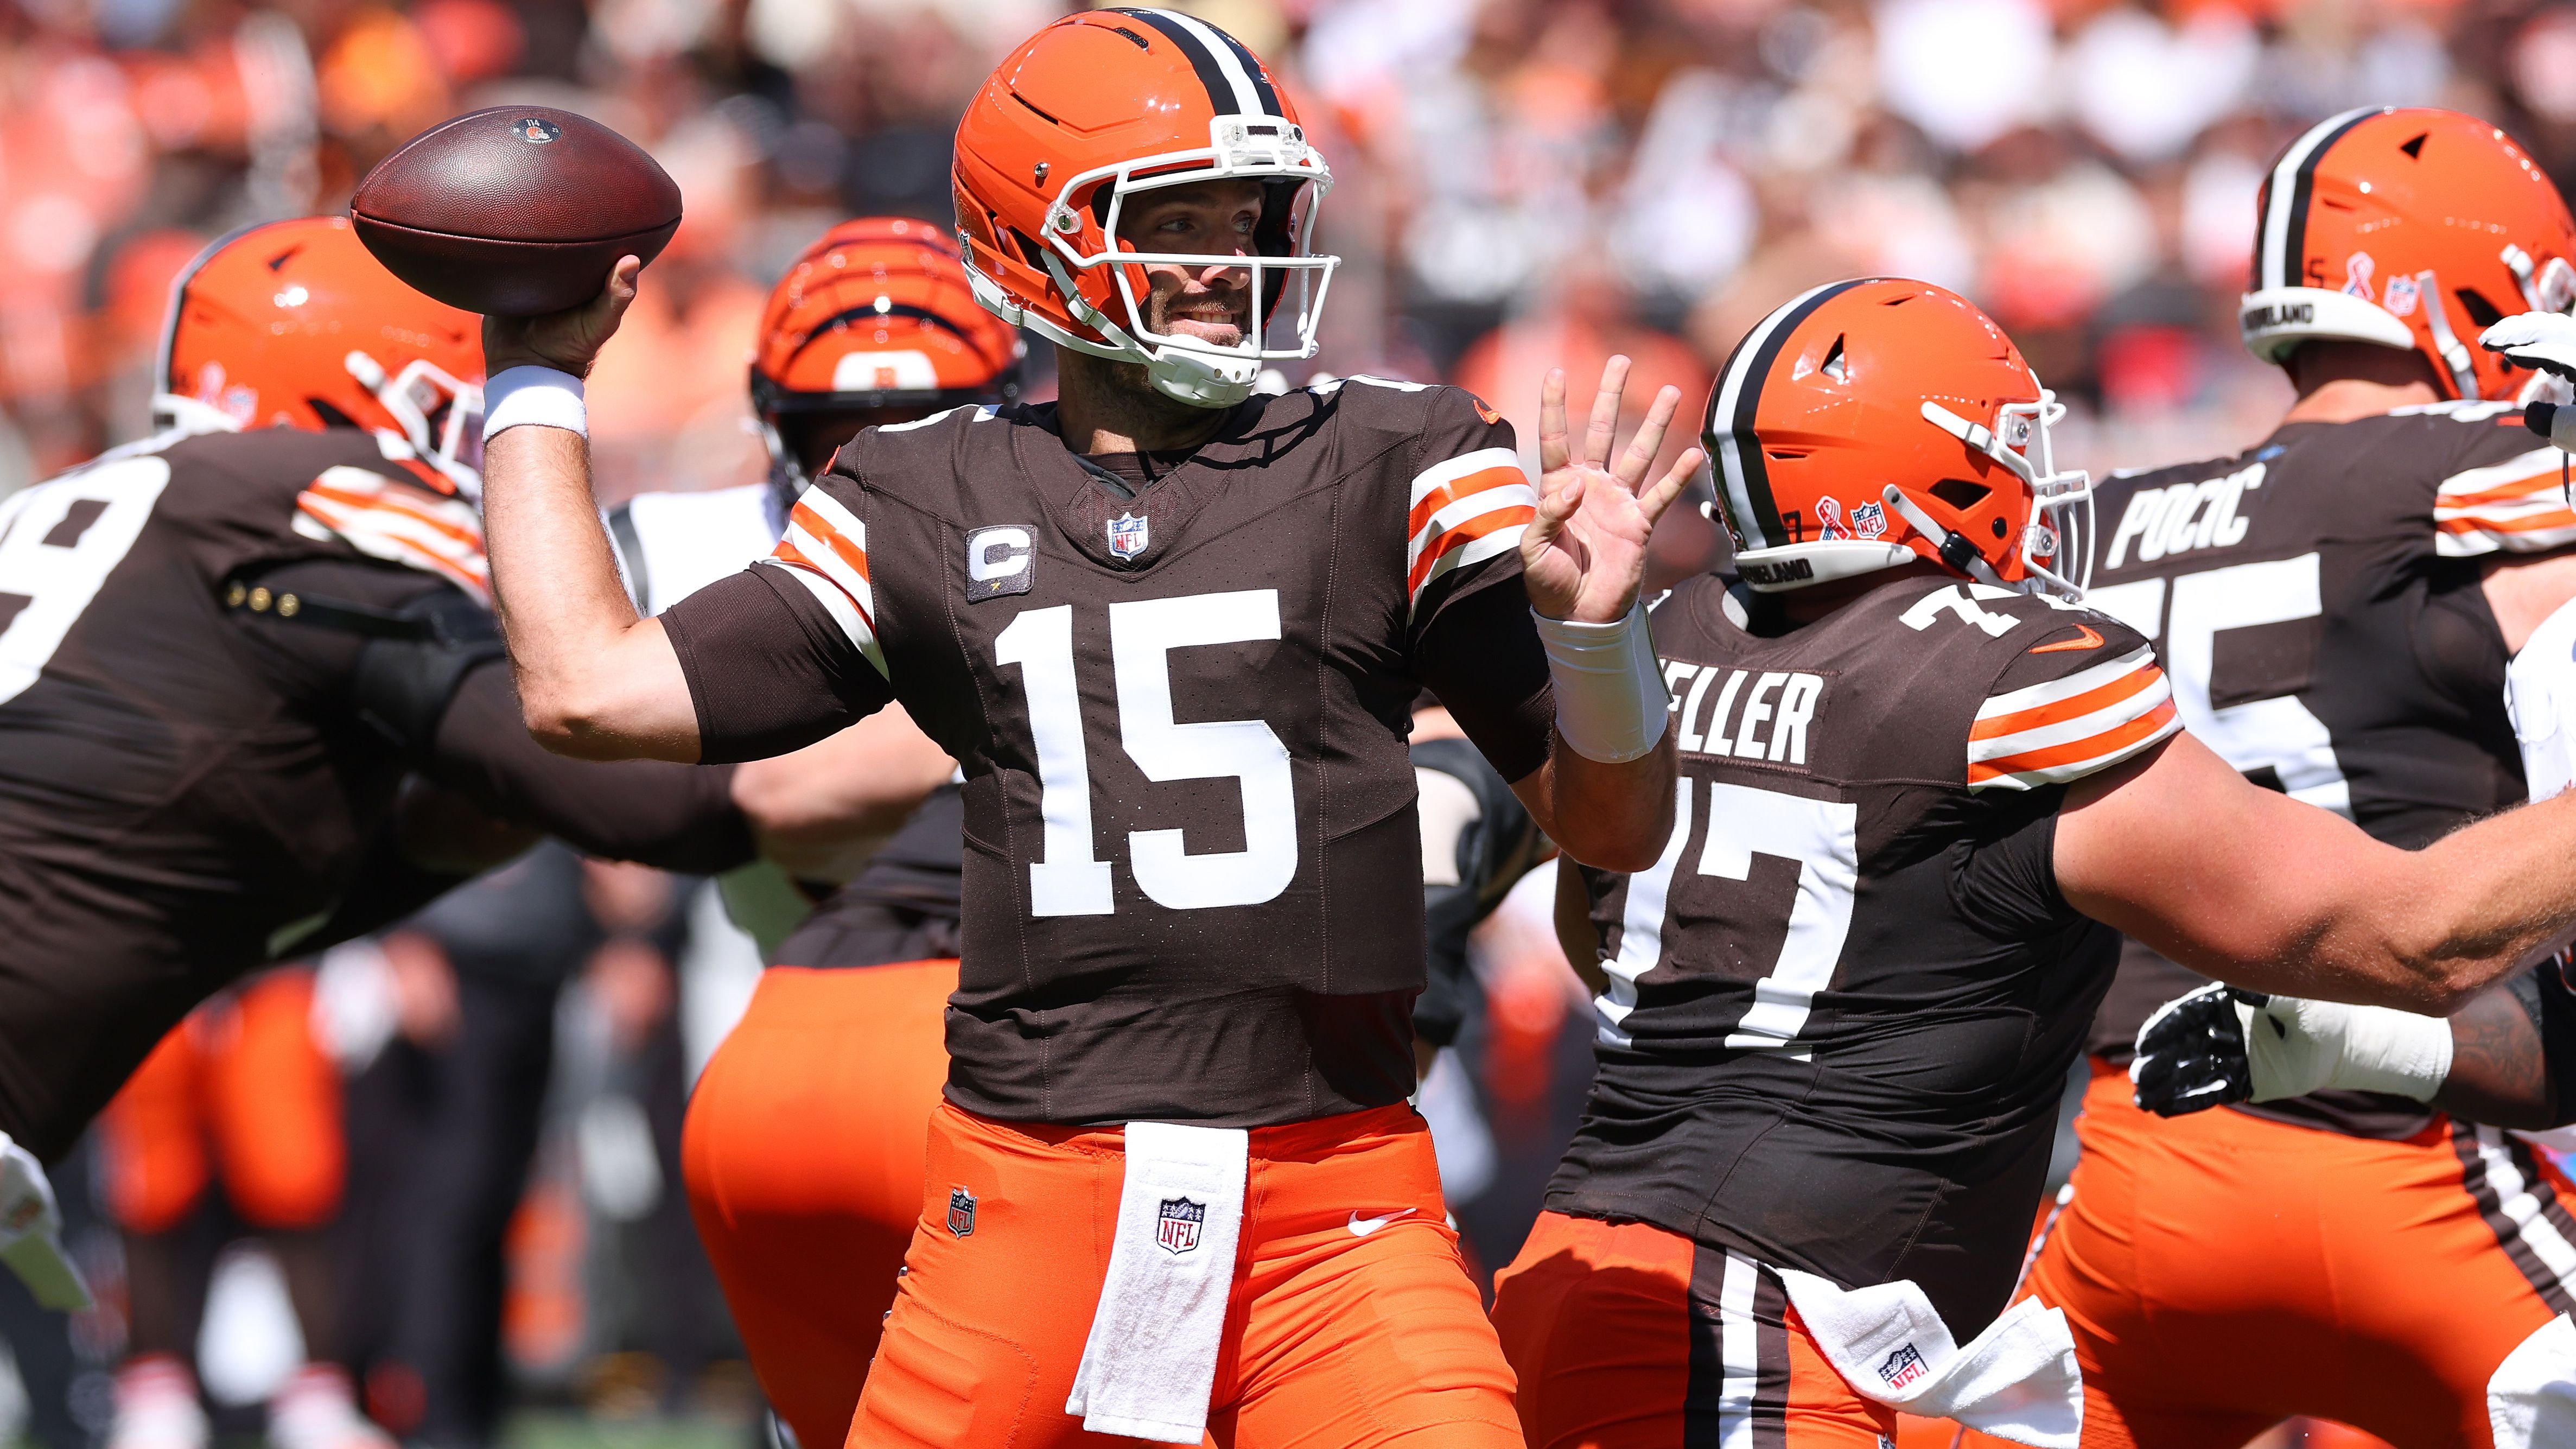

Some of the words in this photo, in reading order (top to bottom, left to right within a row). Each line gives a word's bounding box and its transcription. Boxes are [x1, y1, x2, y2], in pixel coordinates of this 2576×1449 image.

[1859, 517, 1882, 533] NFL
[2104, 462, 2267, 570] POCIC
[969, 528, 1031, 582] C
[1115, 533, 1141, 551] NFL
[1659, 658, 1824, 765] ELLER
[994, 588, 1299, 917] 15
[951, 1208, 969, 1230] NFL
[1160, 1220, 1194, 1249] NFL
[1891, 1363, 1926, 1390] NFL
